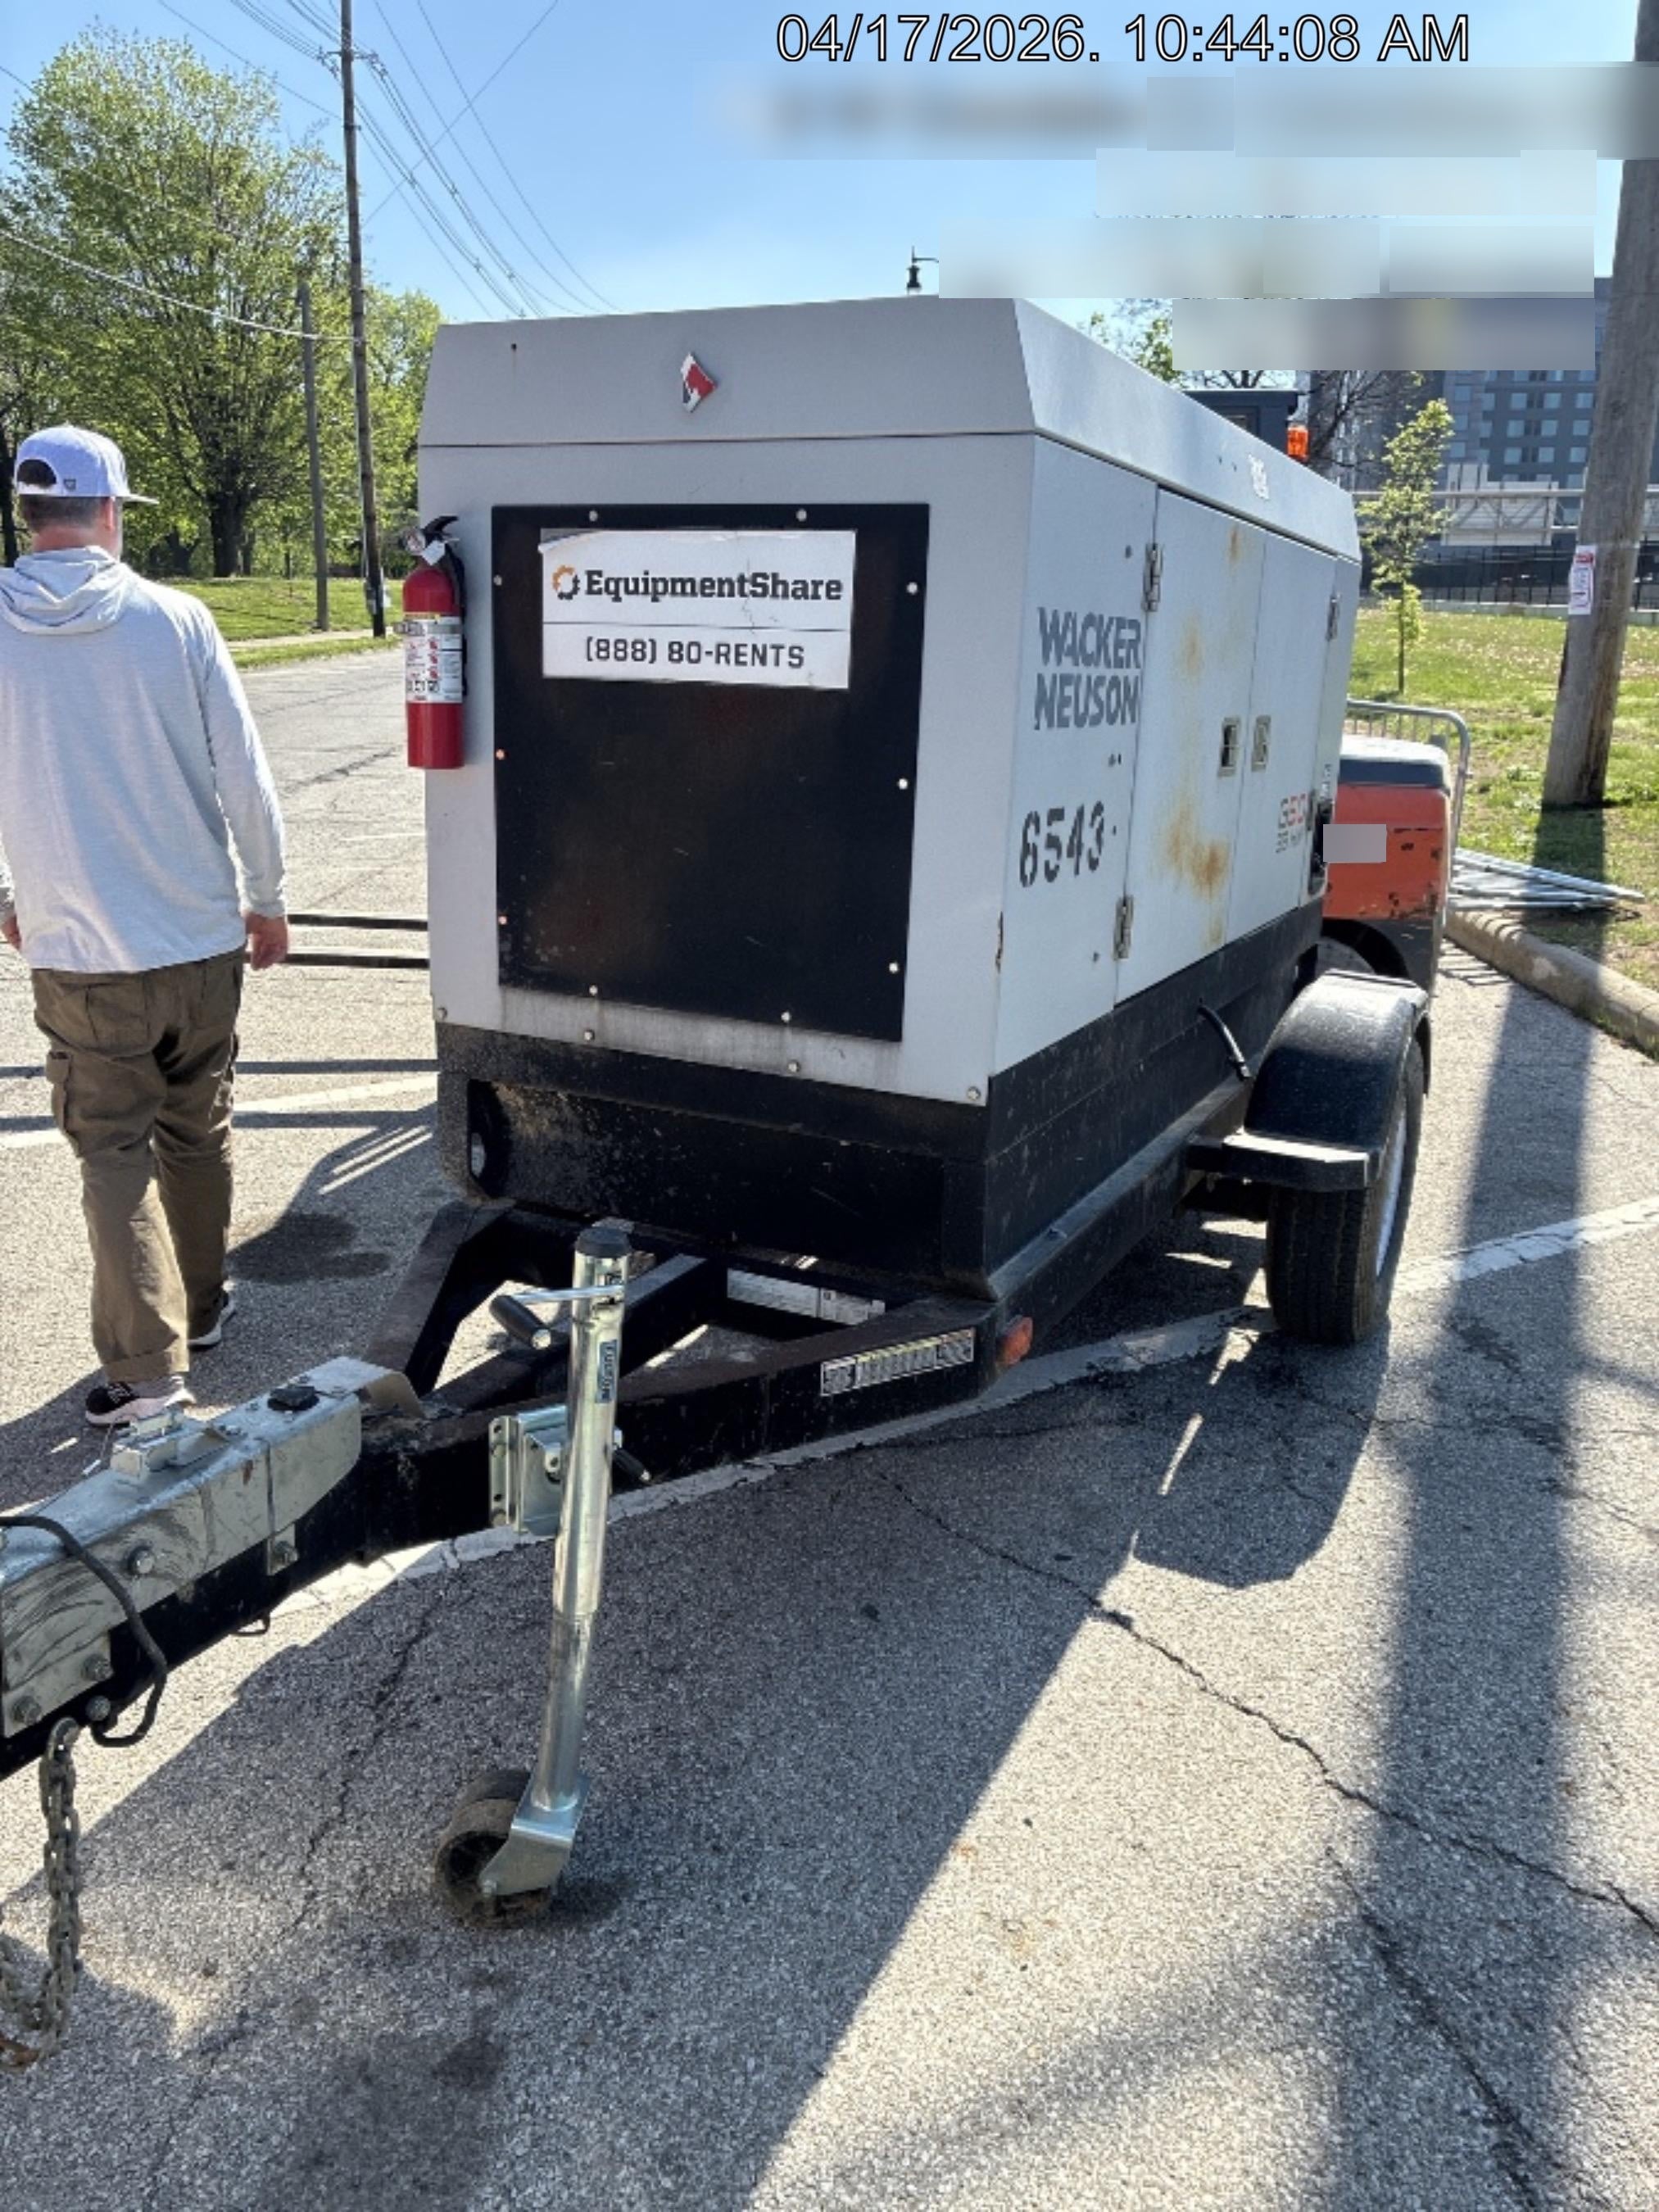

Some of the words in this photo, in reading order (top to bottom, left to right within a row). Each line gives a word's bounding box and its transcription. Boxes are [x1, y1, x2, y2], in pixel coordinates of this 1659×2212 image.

[584, 569, 843, 603] EquipmentShare
[586, 636, 656, 664] (888)
[668, 641, 805, 669] 80-RENTS
[1037, 607, 1141, 669] WACKER
[1034, 673, 1140, 730] NEUSON
[1019, 800, 1105, 887] 6543
